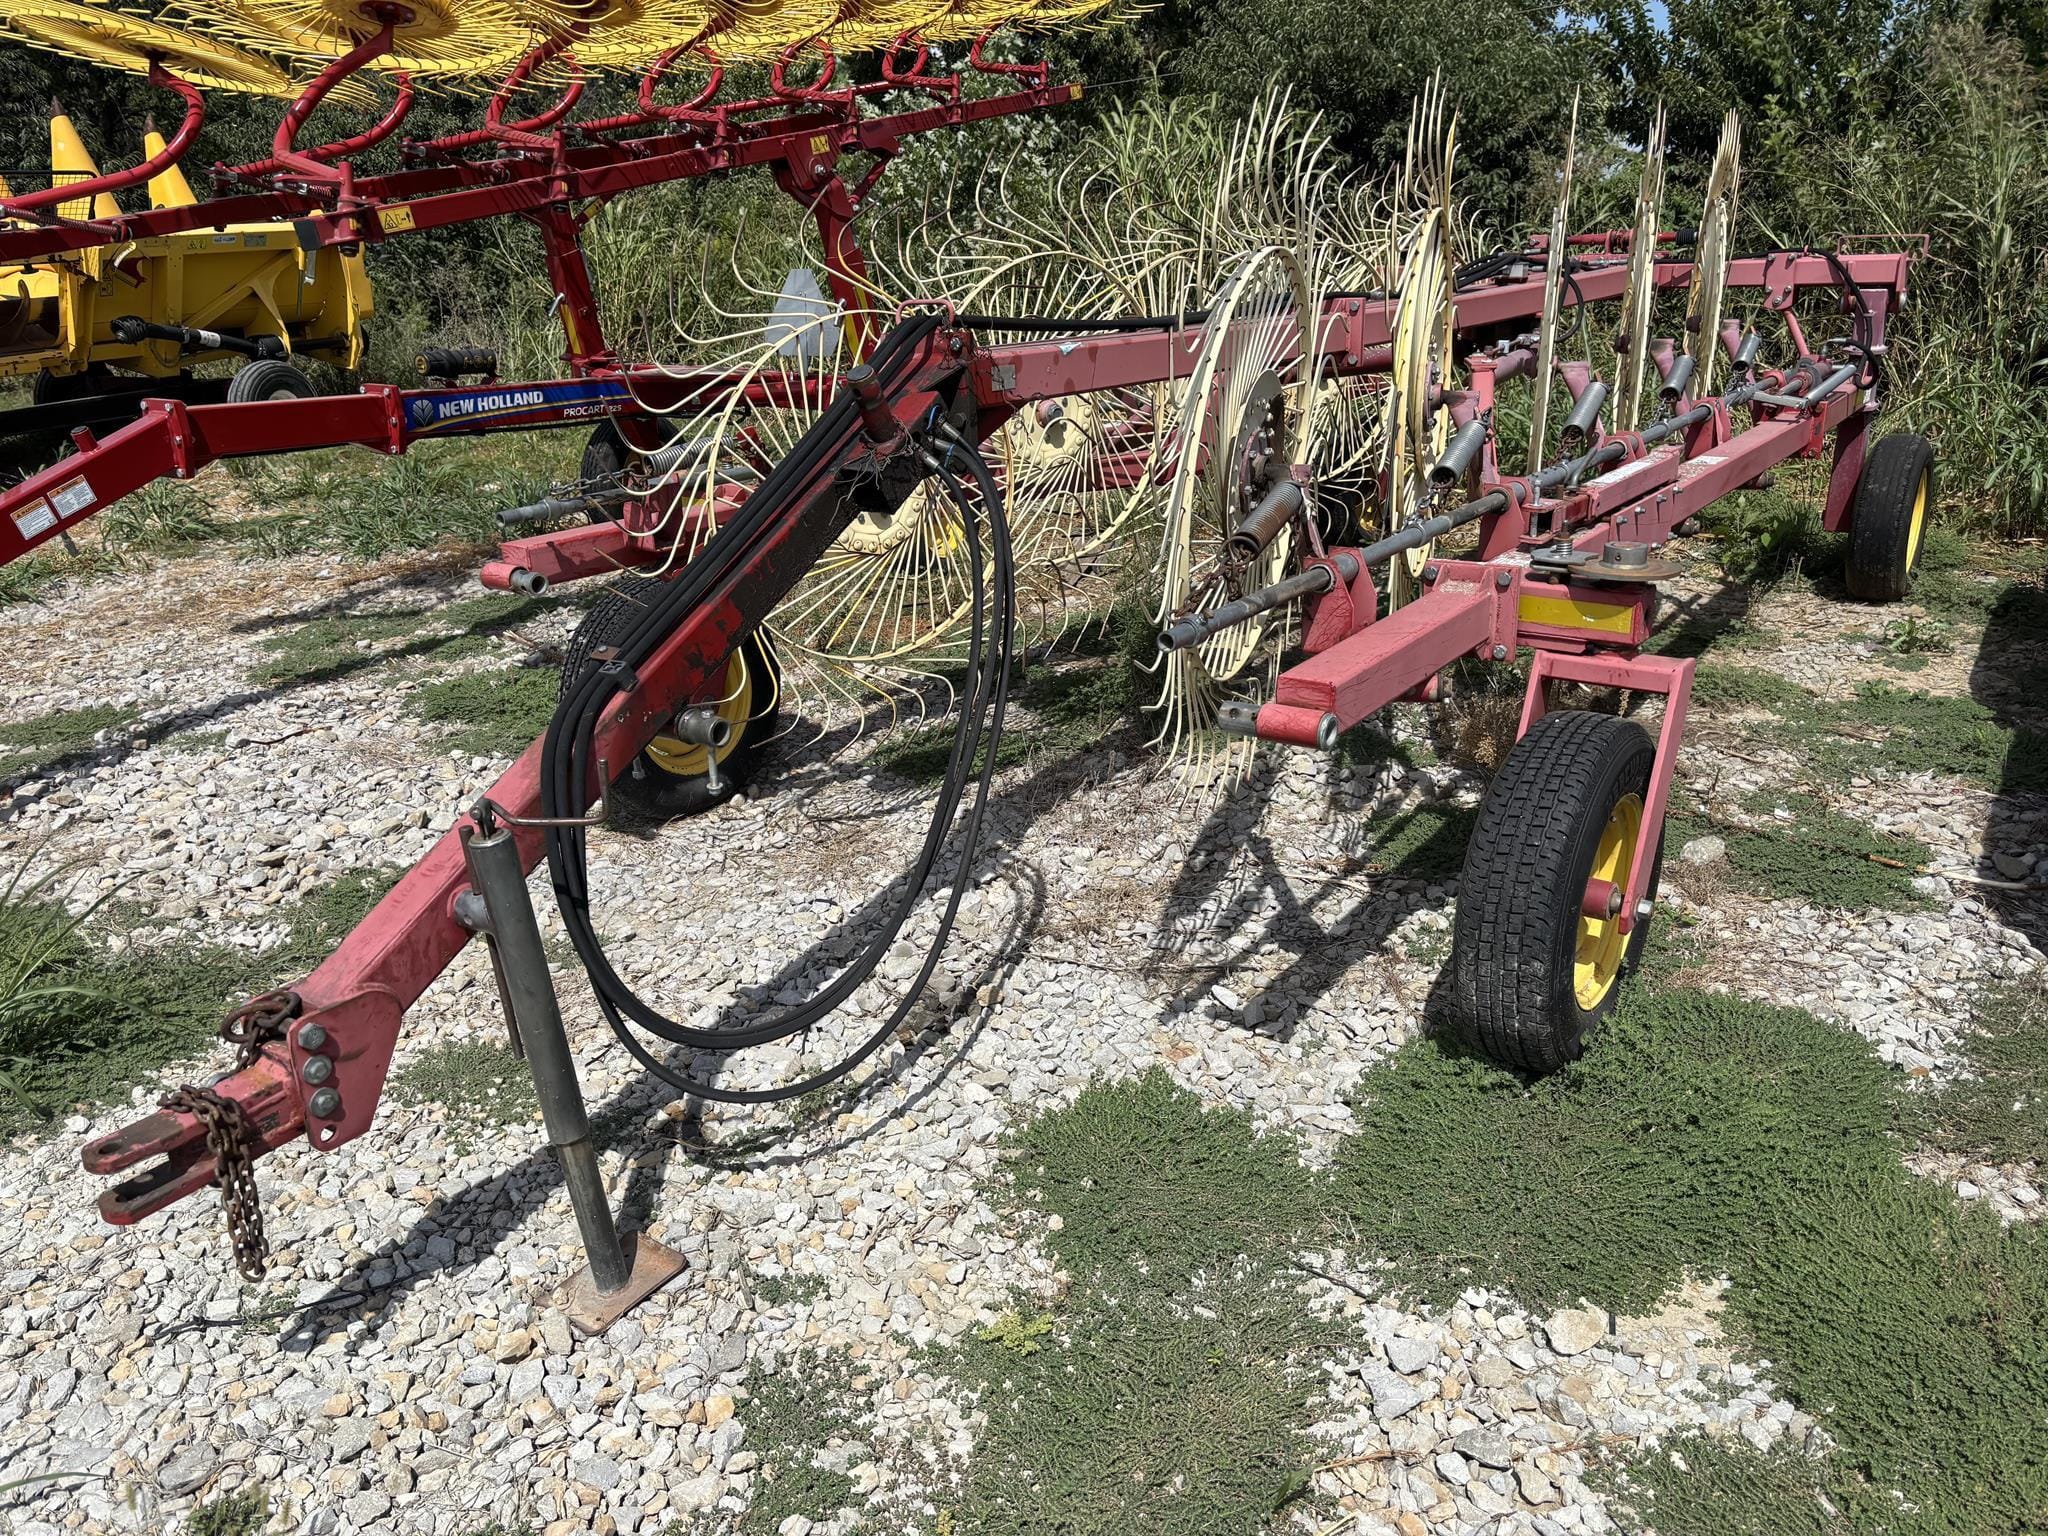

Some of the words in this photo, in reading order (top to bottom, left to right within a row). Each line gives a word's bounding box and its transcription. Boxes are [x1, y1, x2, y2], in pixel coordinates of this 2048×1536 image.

[438, 398, 475, 419] NEW
[477, 391, 544, 412] HOLLAND
[563, 404, 605, 418] PROCART
